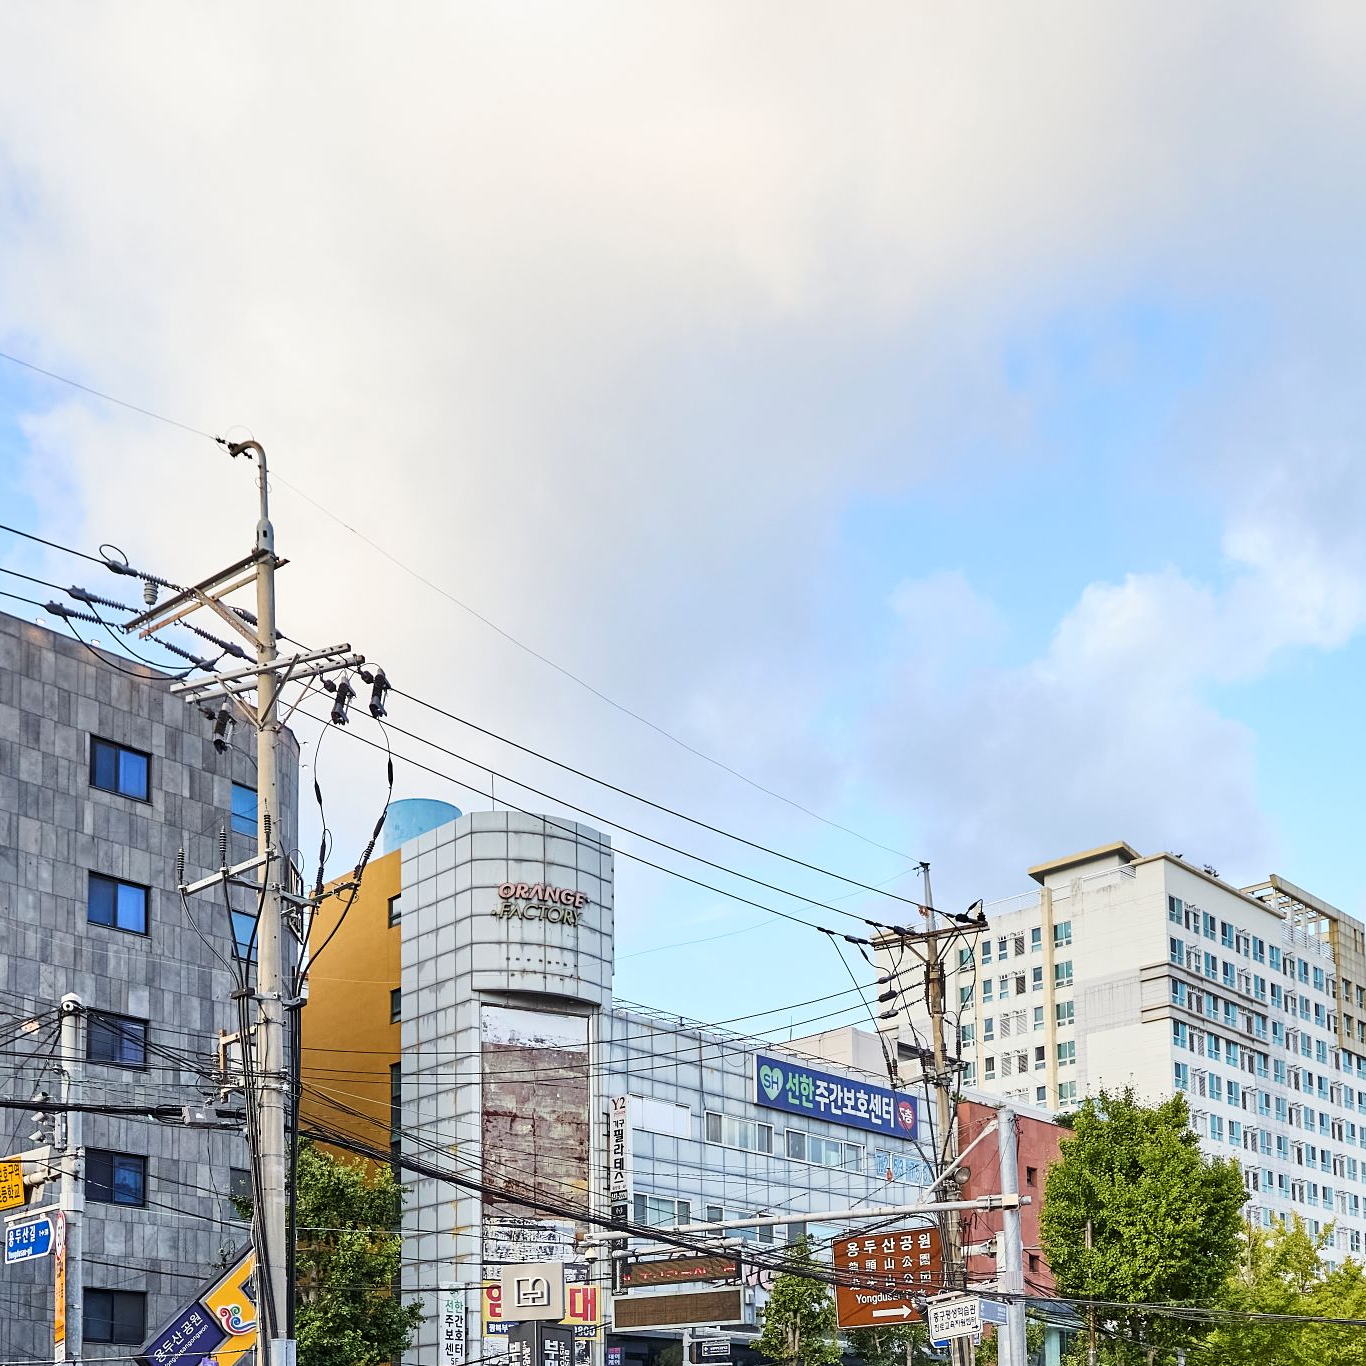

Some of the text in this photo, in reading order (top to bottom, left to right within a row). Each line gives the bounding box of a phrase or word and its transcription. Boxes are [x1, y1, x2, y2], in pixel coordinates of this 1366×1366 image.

[498, 883, 587, 908] ORANGE
[499, 902, 583, 927] FACTORY
[763, 1073, 779, 1091] SH
[612, 1097, 626, 1111] Y2
[613, 1129, 625, 1184] 필라테스
[8, 1224, 36, 1248] 용두산길
[847, 1233, 931, 1257] 용두산공원
[445, 1300, 464, 1313] 선한
[445, 1315, 464, 1328] 주간
[445, 1330, 464, 1342] 보호
[445, 1342, 463, 1357] 센터
